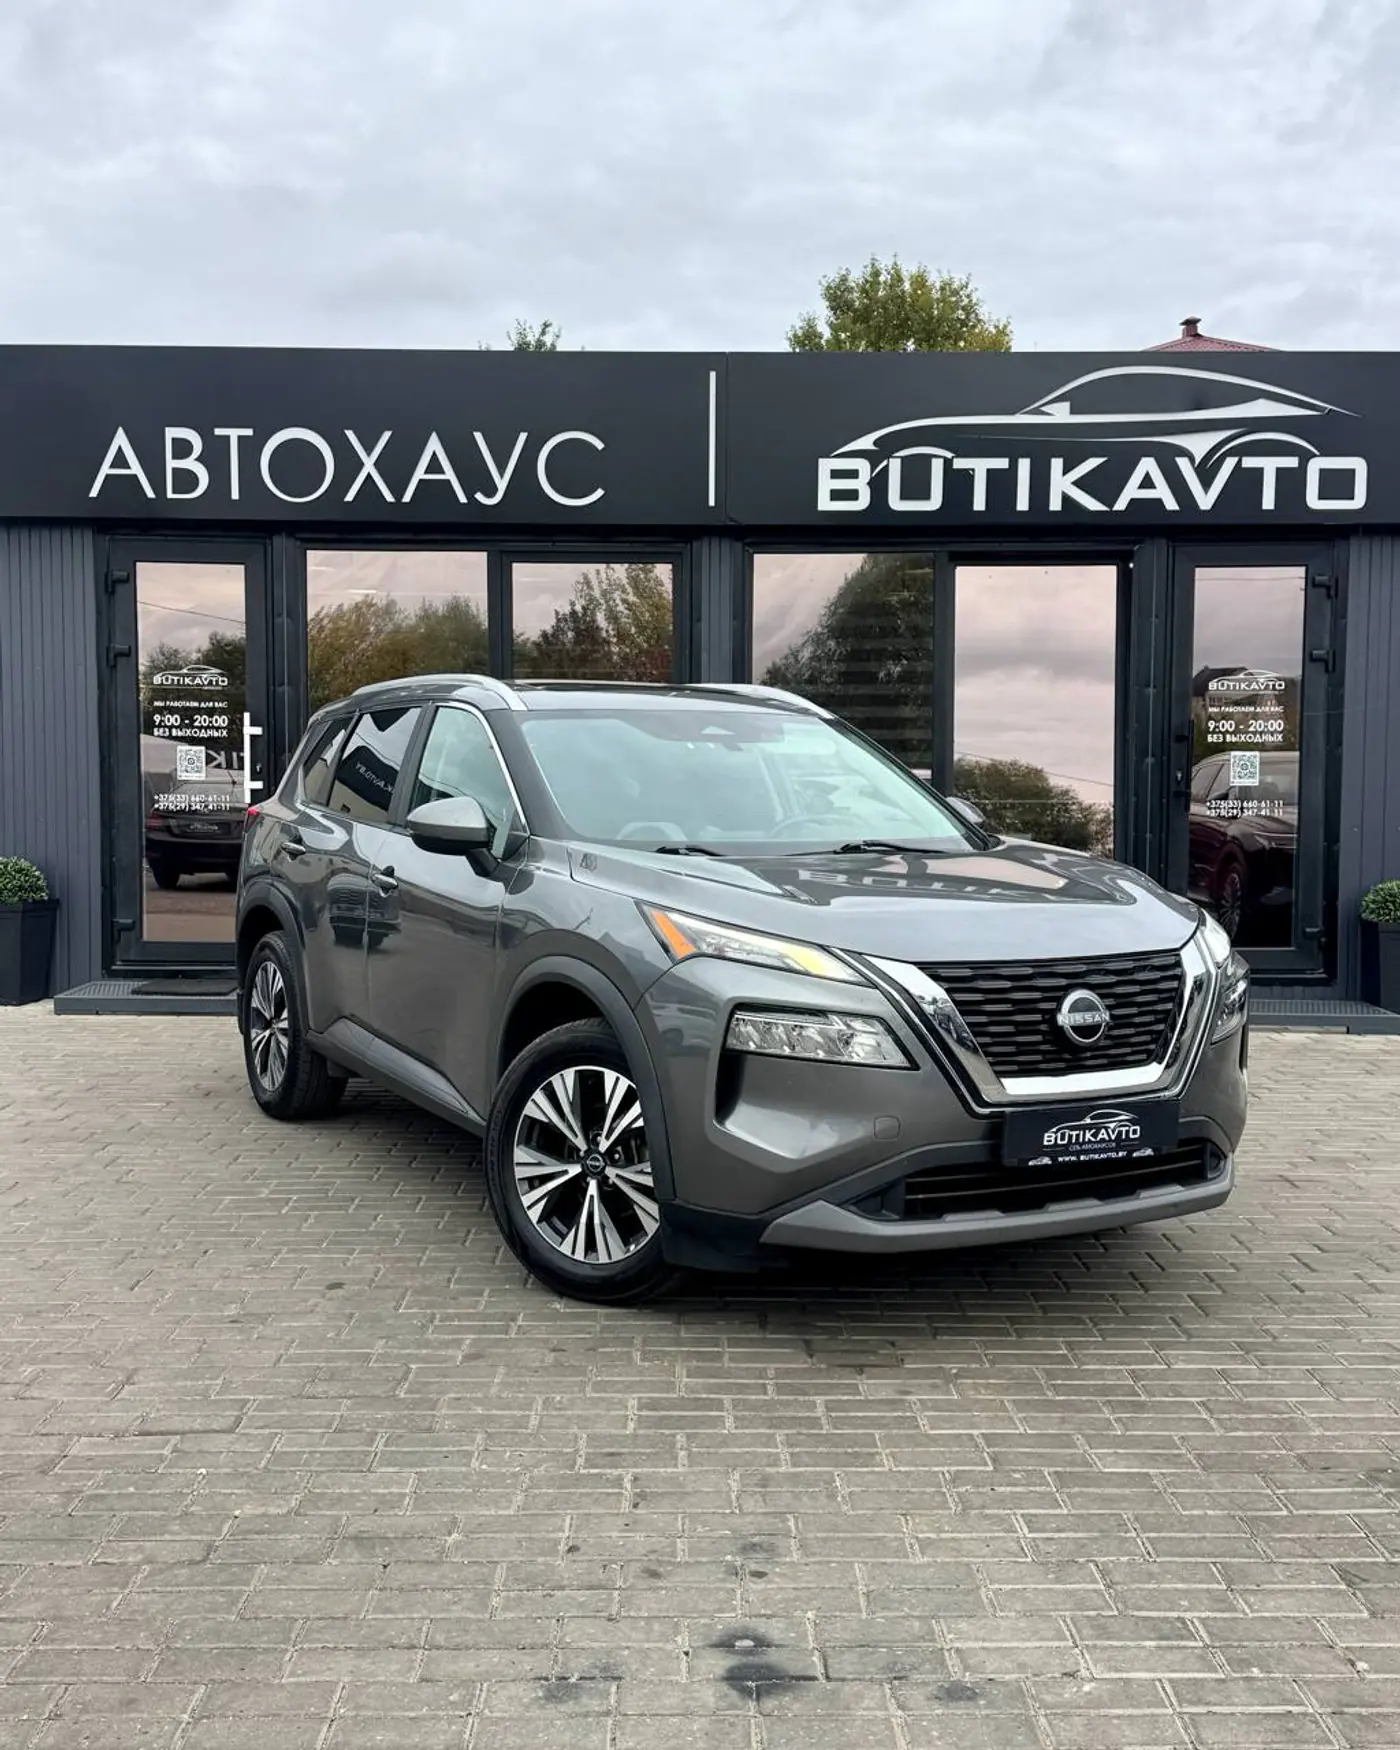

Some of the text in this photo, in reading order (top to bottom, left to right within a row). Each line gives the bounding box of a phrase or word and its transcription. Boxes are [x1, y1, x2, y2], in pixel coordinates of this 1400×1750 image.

[88, 426, 606, 507] АВТОХАУС
[817, 456, 1368, 512] BUTIKAVTO
[153, 676, 228, 686] BUTIKAVTO
[1208, 681, 1285, 691] BUTIKAVTO
[153, 714, 180, 726] 9:00
[193, 715, 228, 727] 20:00
[1208, 720, 1235, 732] 9:00
[1248, 720, 1284, 732] 20:00
[153, 728, 228, 738] БЕЗ ВЫХОДНЫХ
[1207, 734, 1283, 743] БЕЗ ВЫХОДНЫХ
[1058, 1011, 1110, 1025] NISSAN
[1043, 1125, 1141, 1146] BUTIKAVTO
